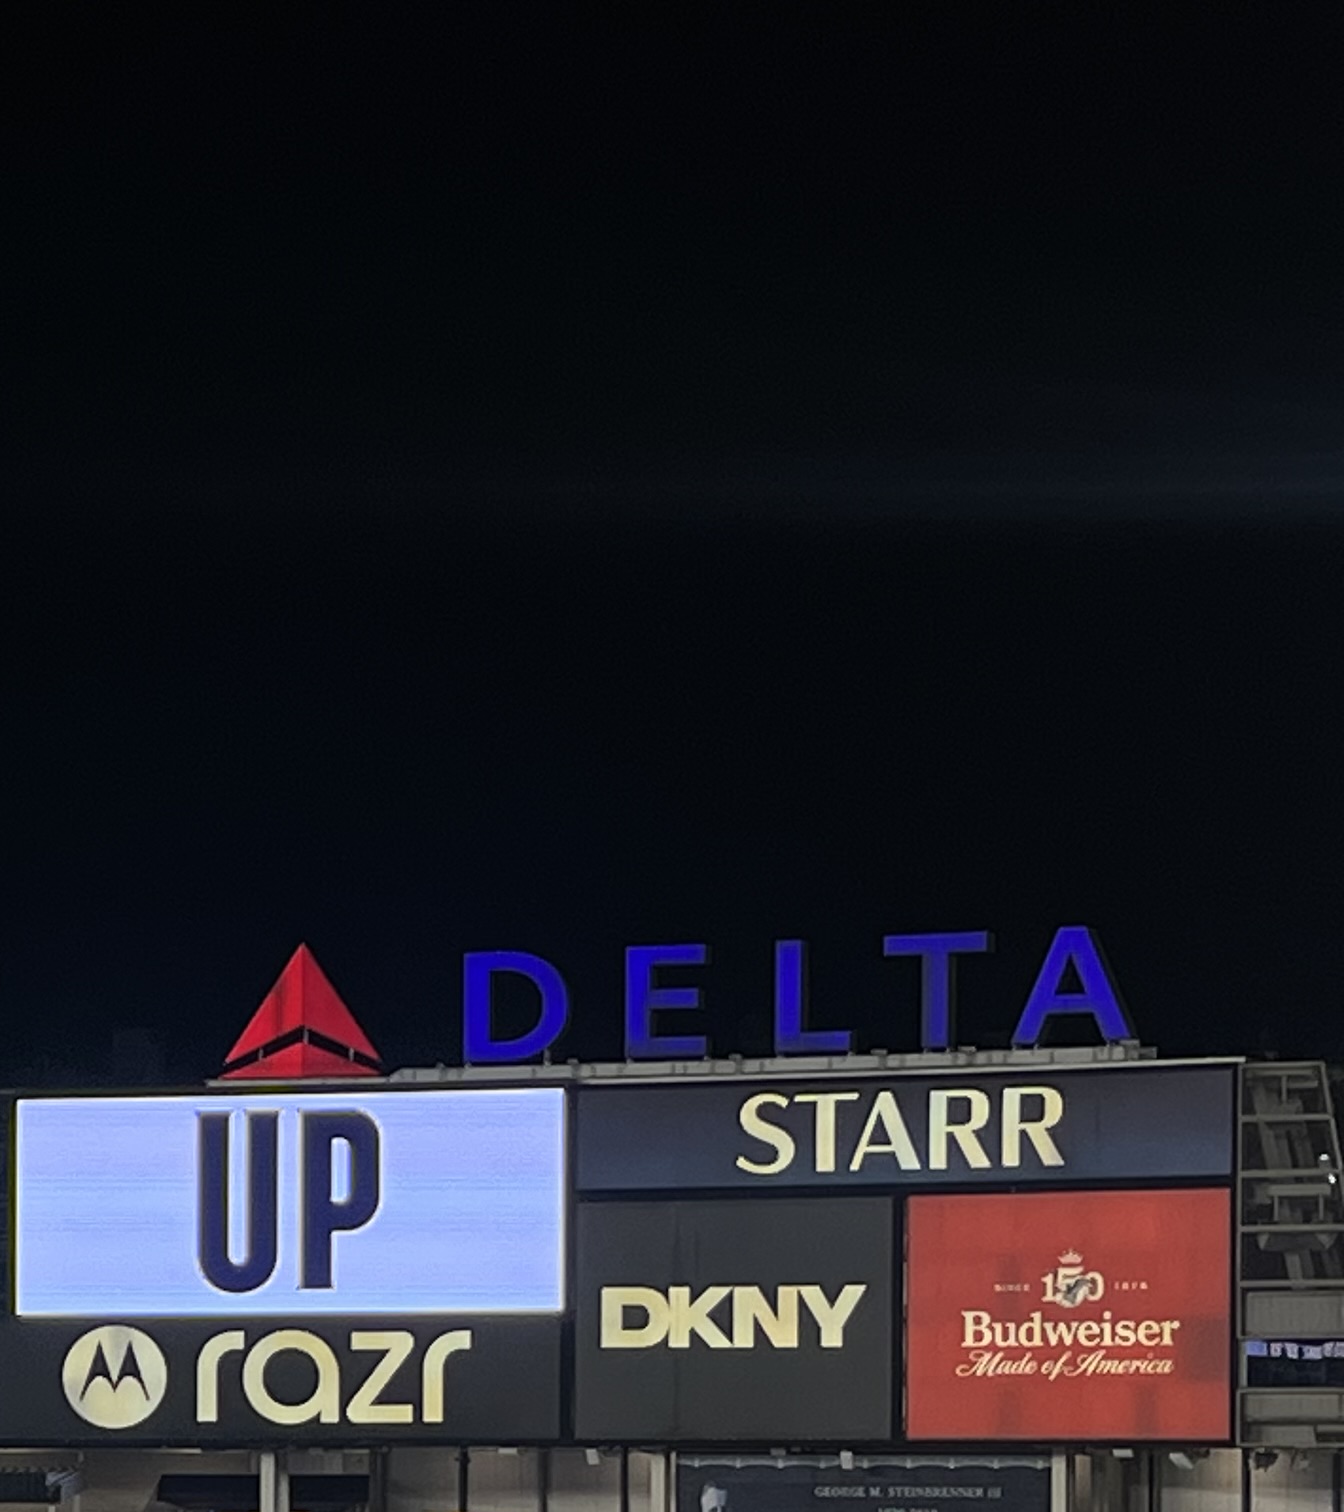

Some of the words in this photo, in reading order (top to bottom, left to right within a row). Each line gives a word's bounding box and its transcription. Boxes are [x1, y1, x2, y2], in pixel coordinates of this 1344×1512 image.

[463, 925, 1133, 1062] DELTA
[736, 1086, 1065, 1175] STARR
[196, 1108, 381, 1294] UP
[600, 1284, 867, 1348] DKNY
[961, 1311, 1180, 1348] Budweiser
[196, 1330, 472, 1426] razr
[956, 1351, 1036, 1377] Made
[1041, 1351, 1072, 1381] of
[1064, 1350, 1174, 1376] America
[814, 1486, 865, 1498] GEORGE
